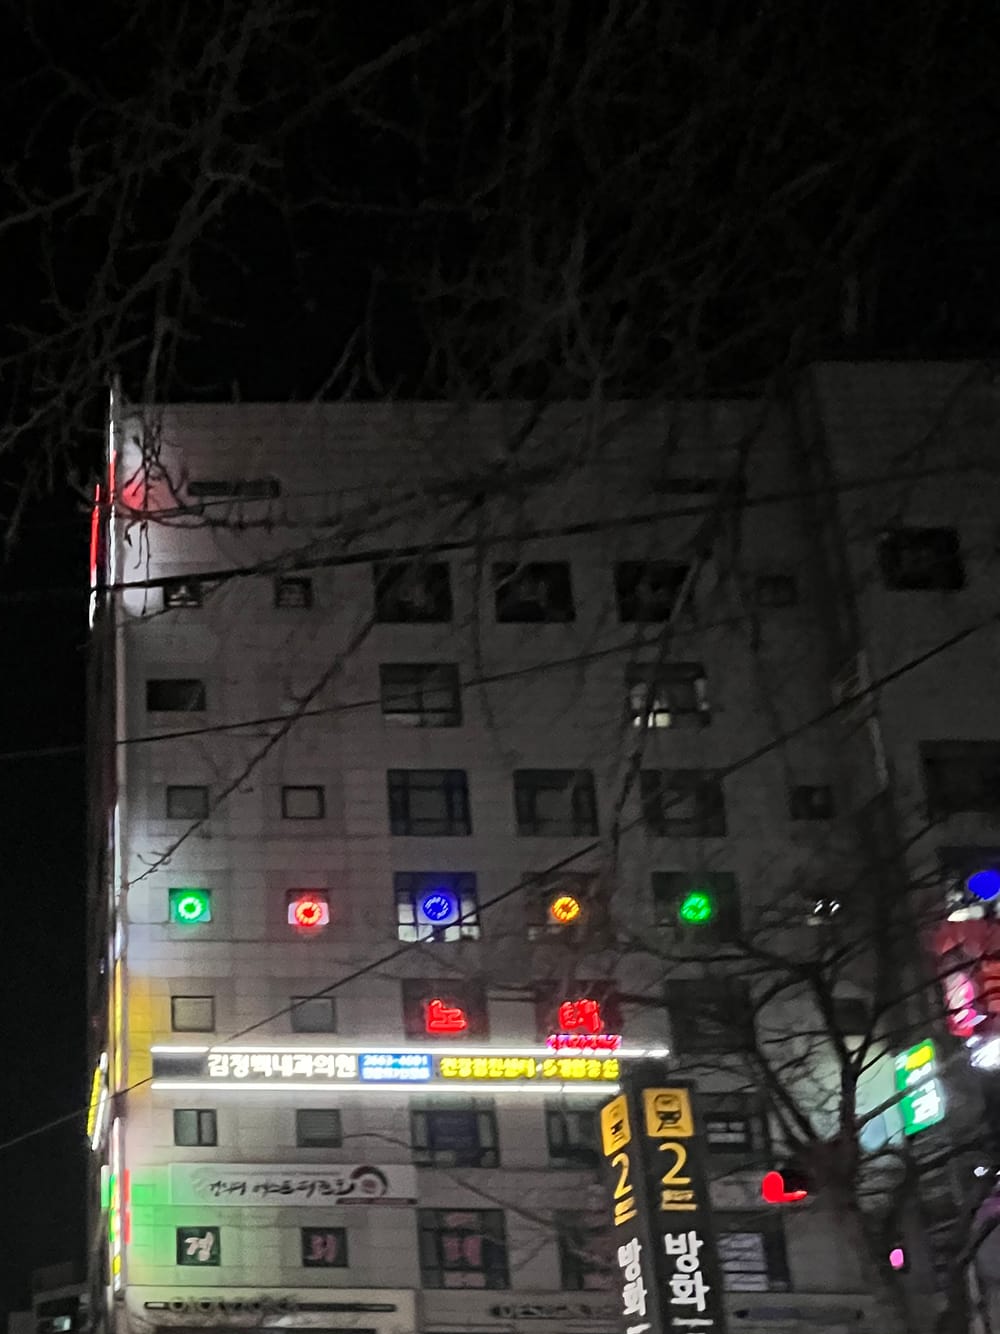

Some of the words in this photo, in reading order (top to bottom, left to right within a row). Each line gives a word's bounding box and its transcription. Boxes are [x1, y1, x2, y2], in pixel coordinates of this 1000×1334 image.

[611, 1153, 633, 1199] 2
[659, 1142, 691, 1185] 2
[618, 1238, 648, 1316] 방화
[664, 1231, 711, 1311] 방화
